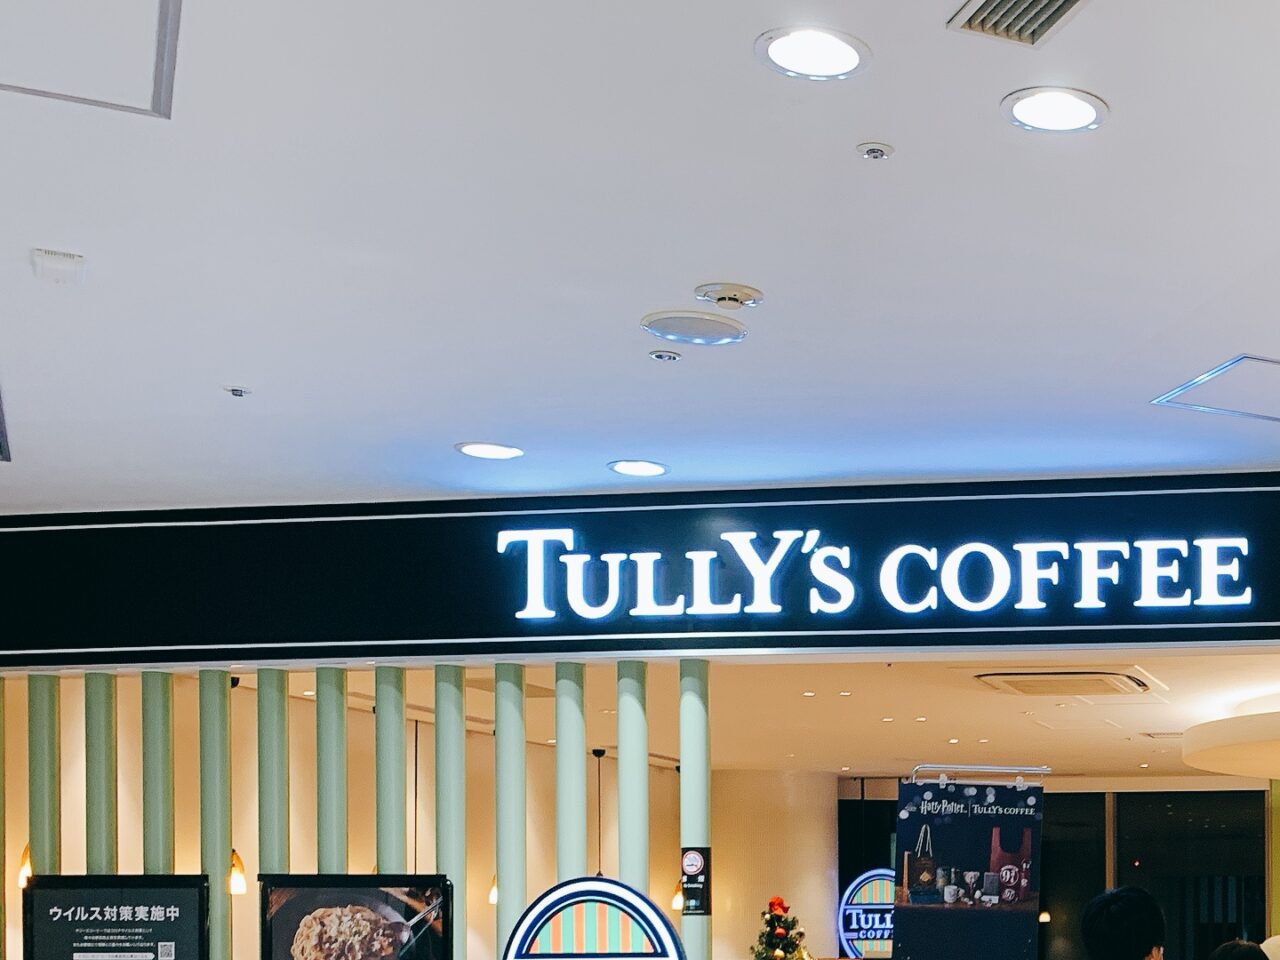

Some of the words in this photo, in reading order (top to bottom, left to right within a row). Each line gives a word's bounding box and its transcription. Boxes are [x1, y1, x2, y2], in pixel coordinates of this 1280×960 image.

[497, 529, 855, 620] TULLY'S
[880, 537, 1251, 613] COFFEE
[920, 800, 940, 815] Harry
[940, 799, 965, 815] Potter
[972, 804, 1003, 814] TULLY'S
[1004, 807, 1036, 815] COFFEE
[49, 905, 180, 921] ウイルス対策実施中
[846, 909, 894, 929] TULL
[859, 930, 893, 938] COFF
